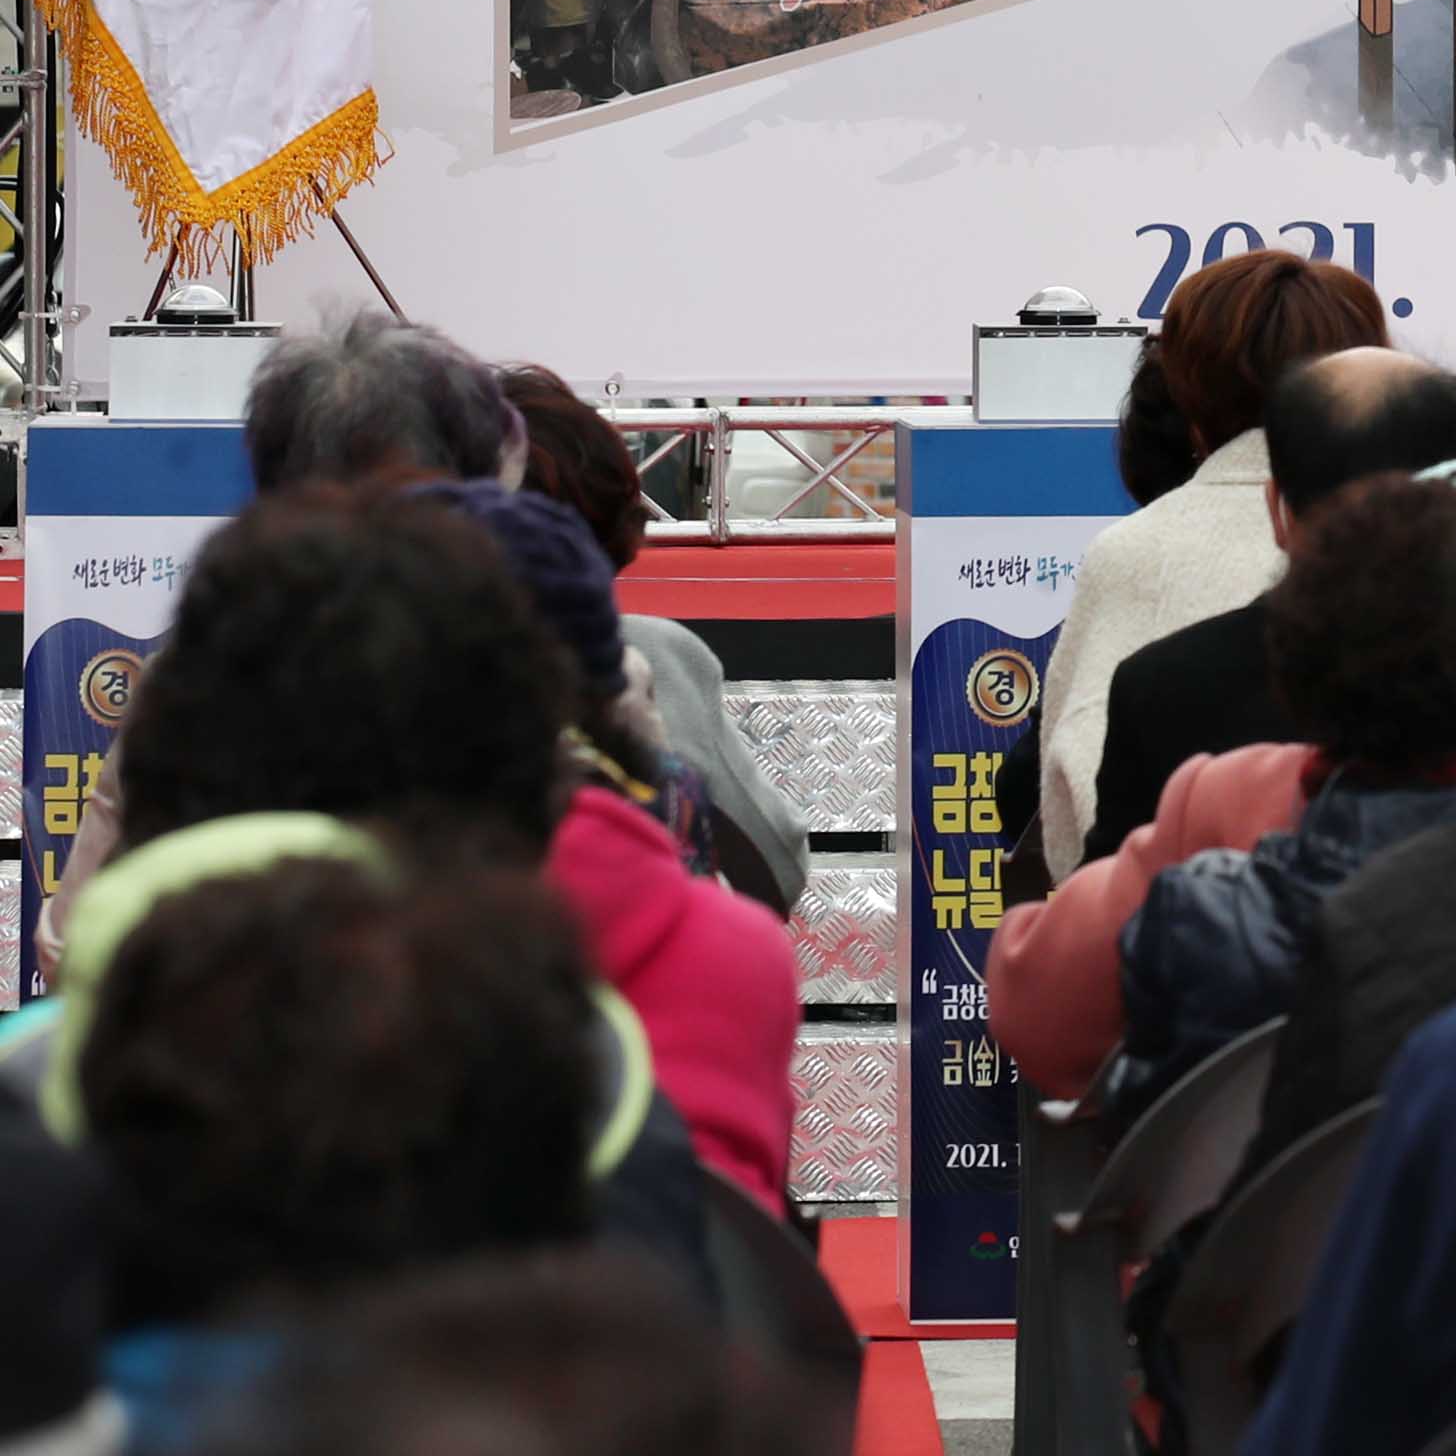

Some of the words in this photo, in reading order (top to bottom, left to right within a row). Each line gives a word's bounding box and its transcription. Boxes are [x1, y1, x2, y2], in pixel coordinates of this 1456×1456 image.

[72, 558, 110, 589] 새로운
[113, 554, 147, 587] 변화
[958, 558, 996, 590] 새로운
[998, 555, 1031, 587] 변화
[1036, 556, 1075, 592] 모두가
[988, 670, 1015, 707] 경
[945, 1143, 1007, 1168] 2021.
